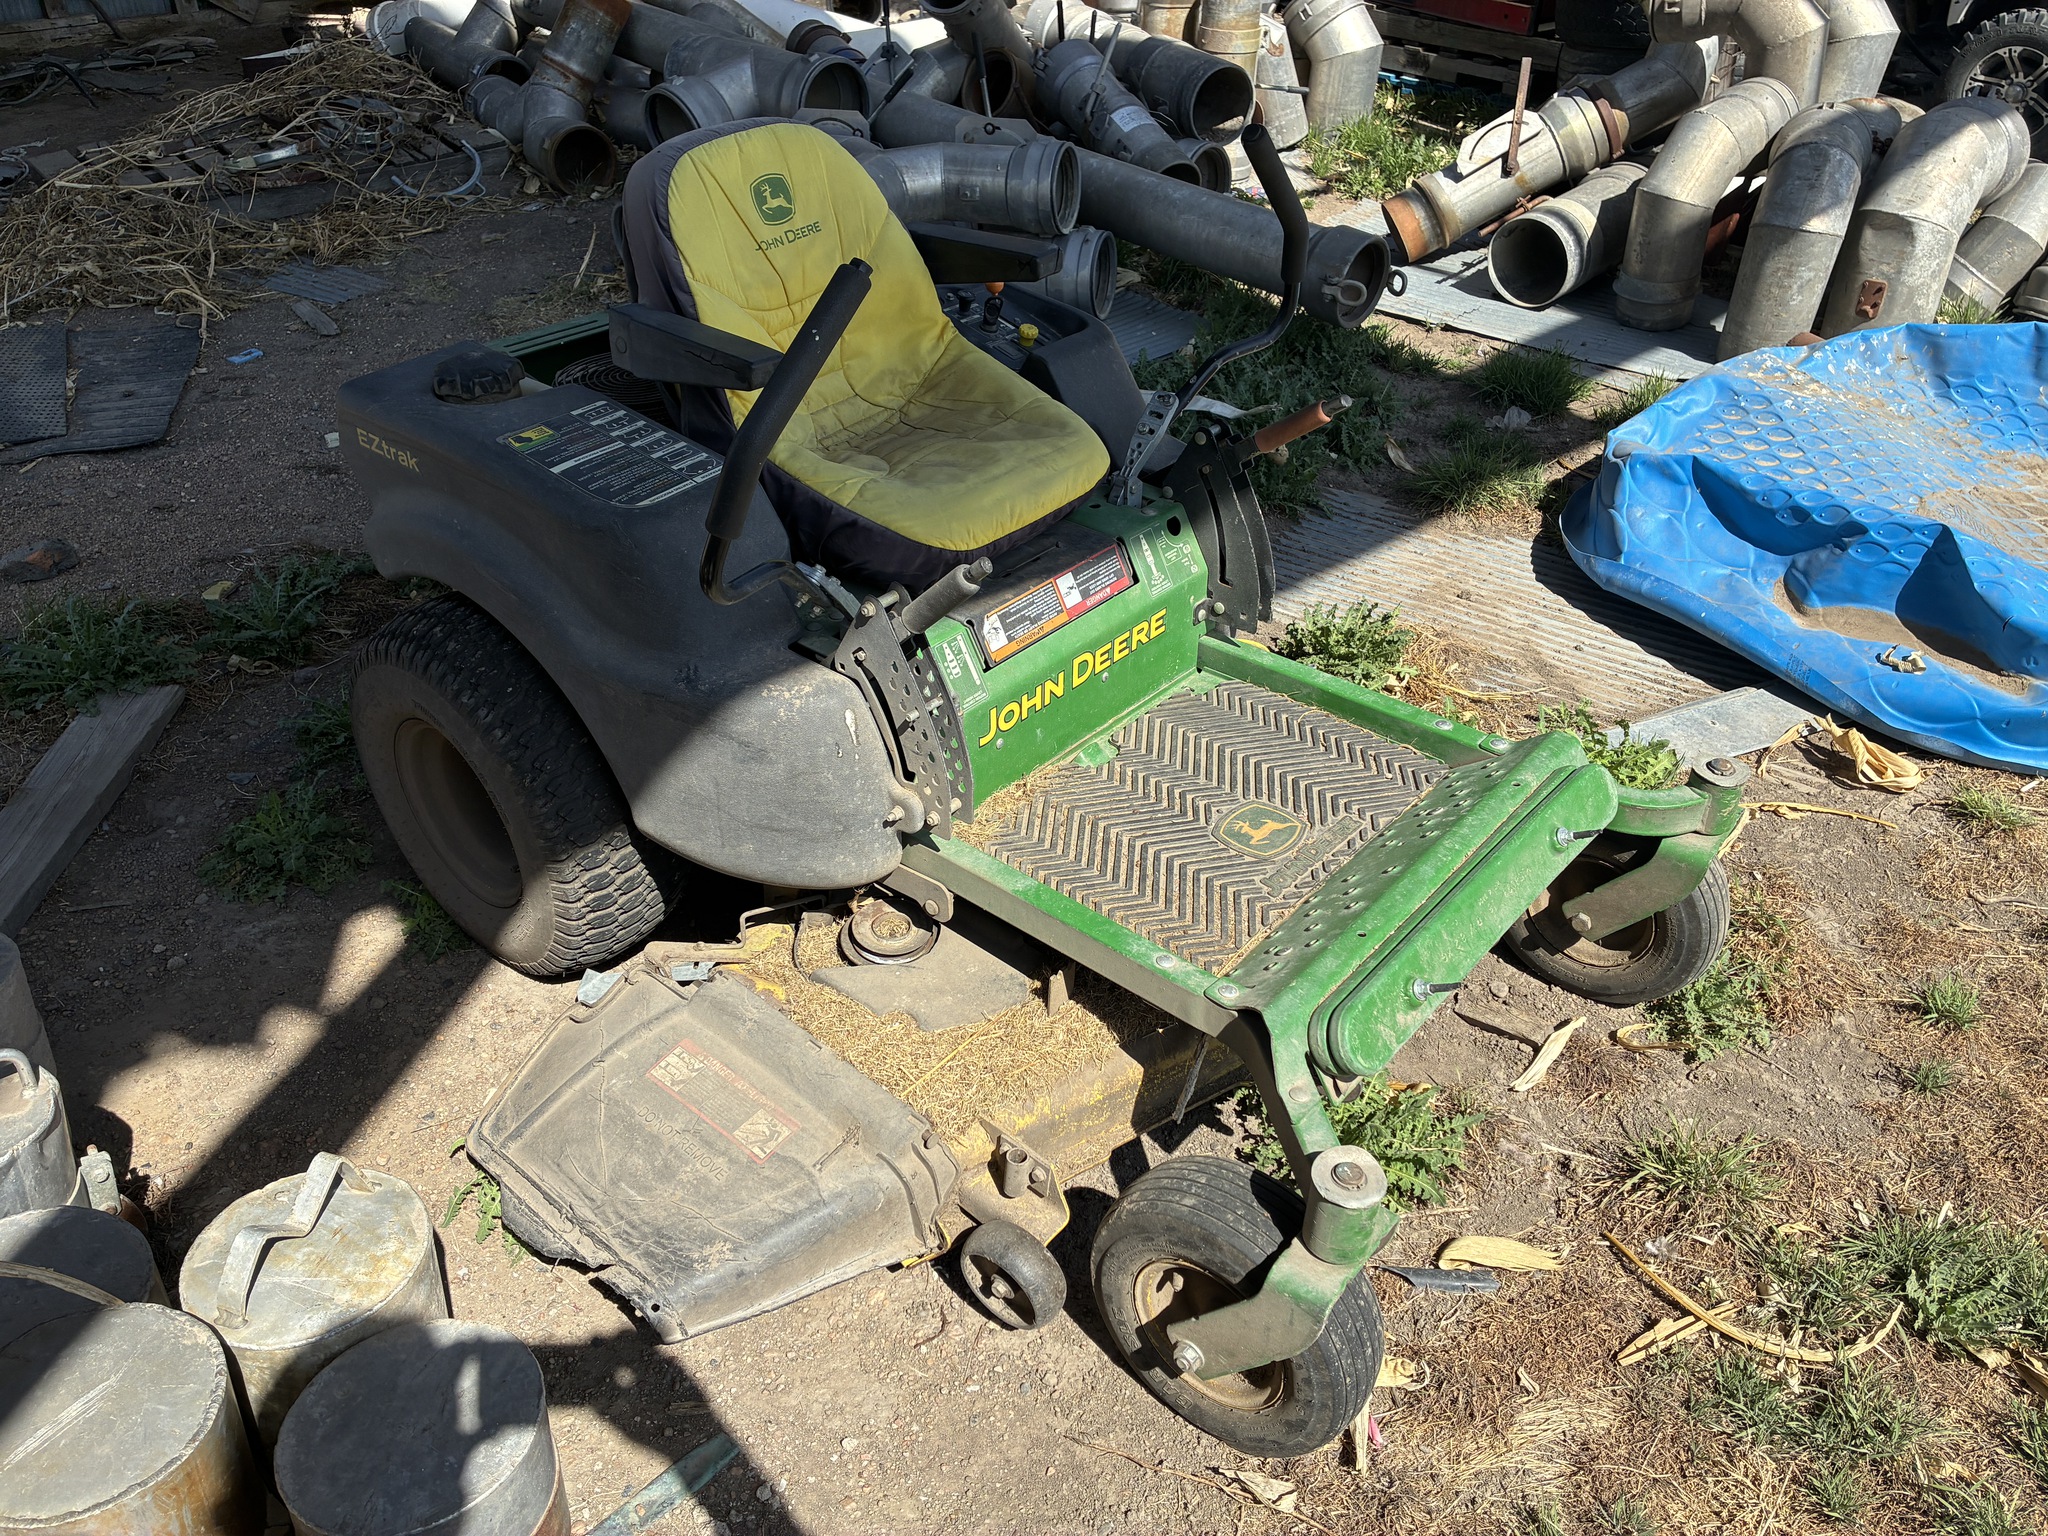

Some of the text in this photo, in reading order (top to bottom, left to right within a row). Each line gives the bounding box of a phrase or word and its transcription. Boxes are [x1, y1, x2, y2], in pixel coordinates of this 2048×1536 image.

[755, 221, 822, 252] JOHN DEERE
[356, 427, 420, 473] EZtrak
[1084, 589, 1107, 606] DANGER
[1014, 627, 1041, 647] WARNING
[979, 670, 1065, 748] JOHN
[1072, 607, 1168, 690] DEERE
[1260, 857, 1315, 898] JOHN
[703, 1055, 736, 1082] DANGER
[637, 1106, 729, 1181] DO NOT REMOVE
